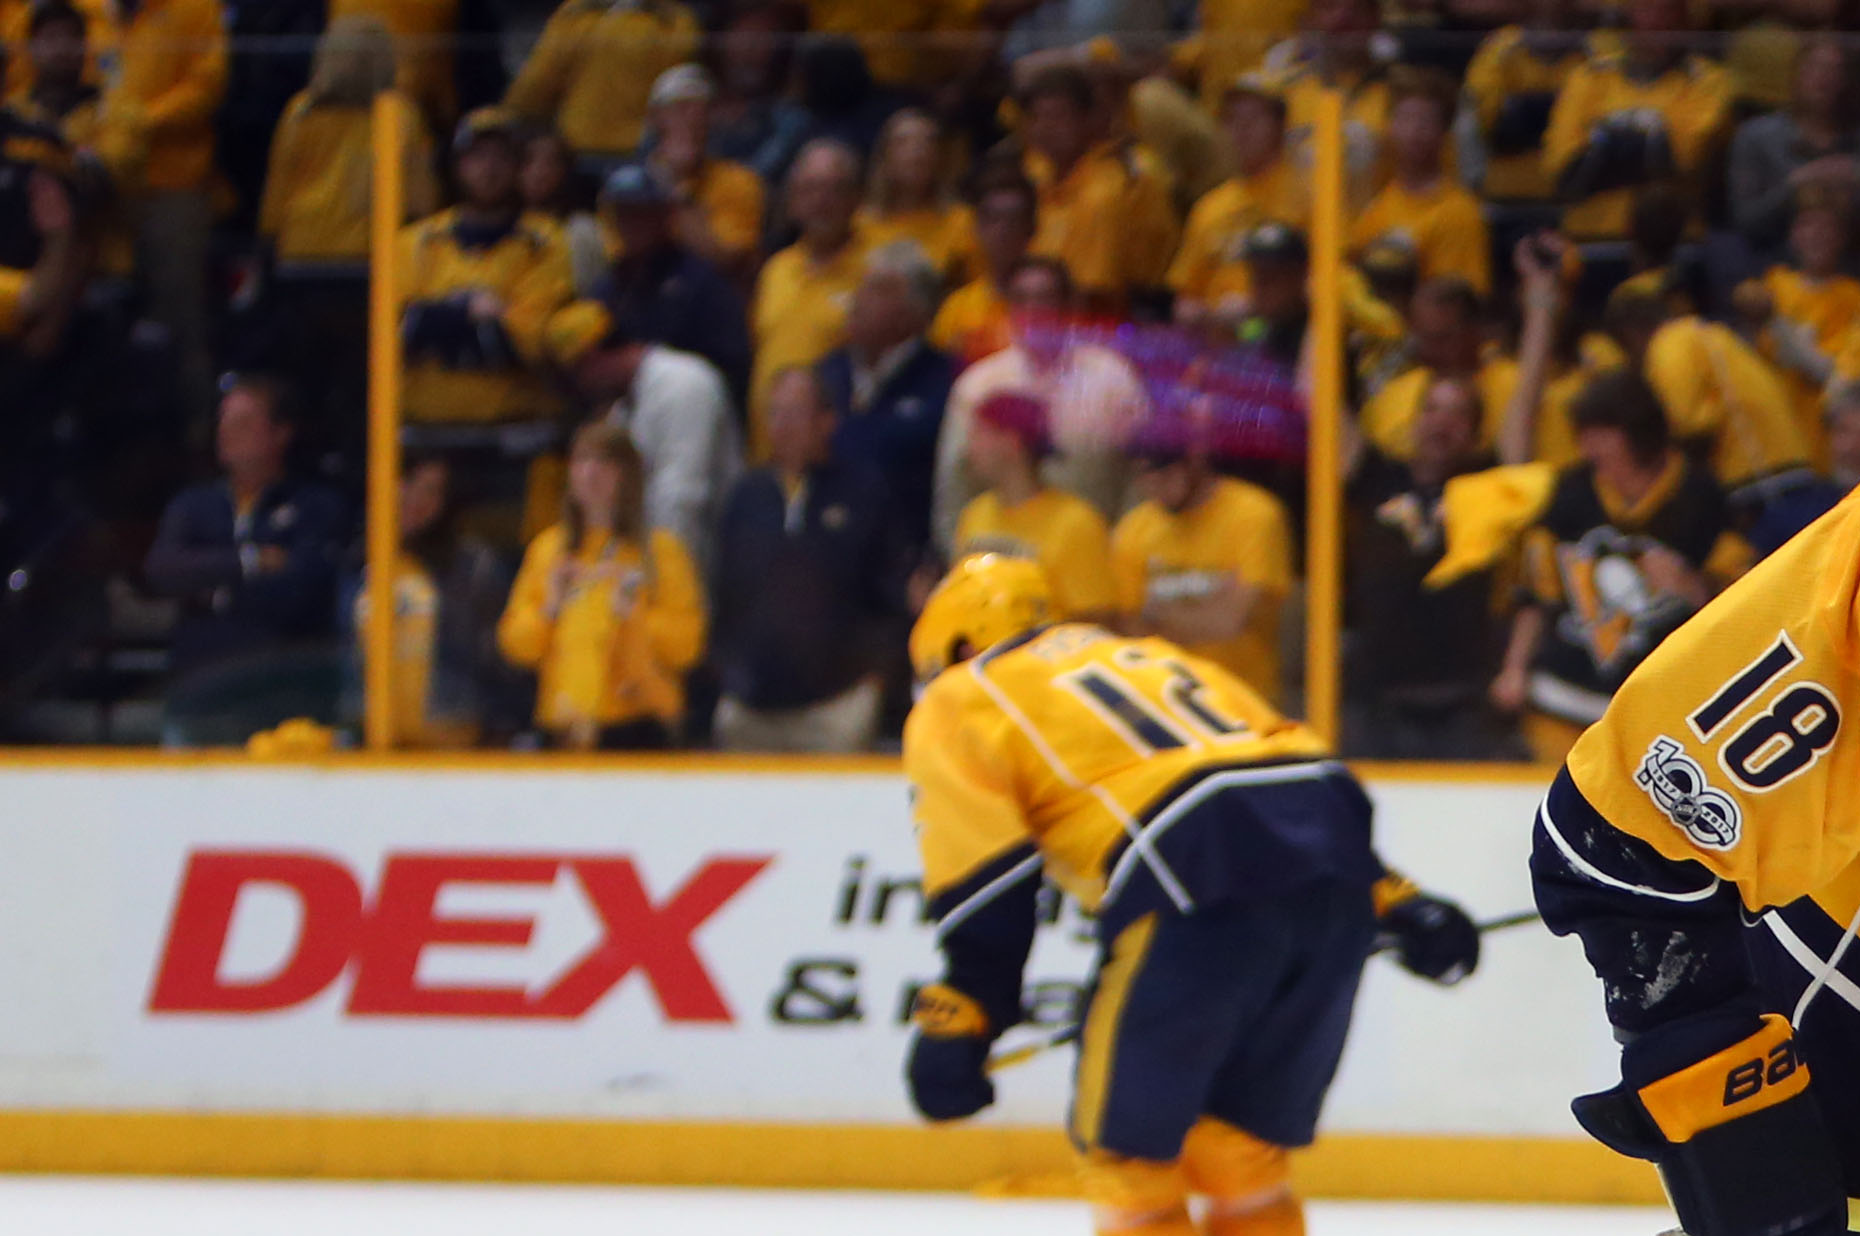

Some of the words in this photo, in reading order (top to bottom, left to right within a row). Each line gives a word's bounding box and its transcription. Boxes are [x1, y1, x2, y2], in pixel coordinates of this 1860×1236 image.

[1686, 629, 1842, 794] 18
[1703, 810, 1729, 834] 2017
[146, 848, 779, 1025] DEX
[769, 957, 865, 1026] &
[1723, 1038, 1797, 1107] Ba
